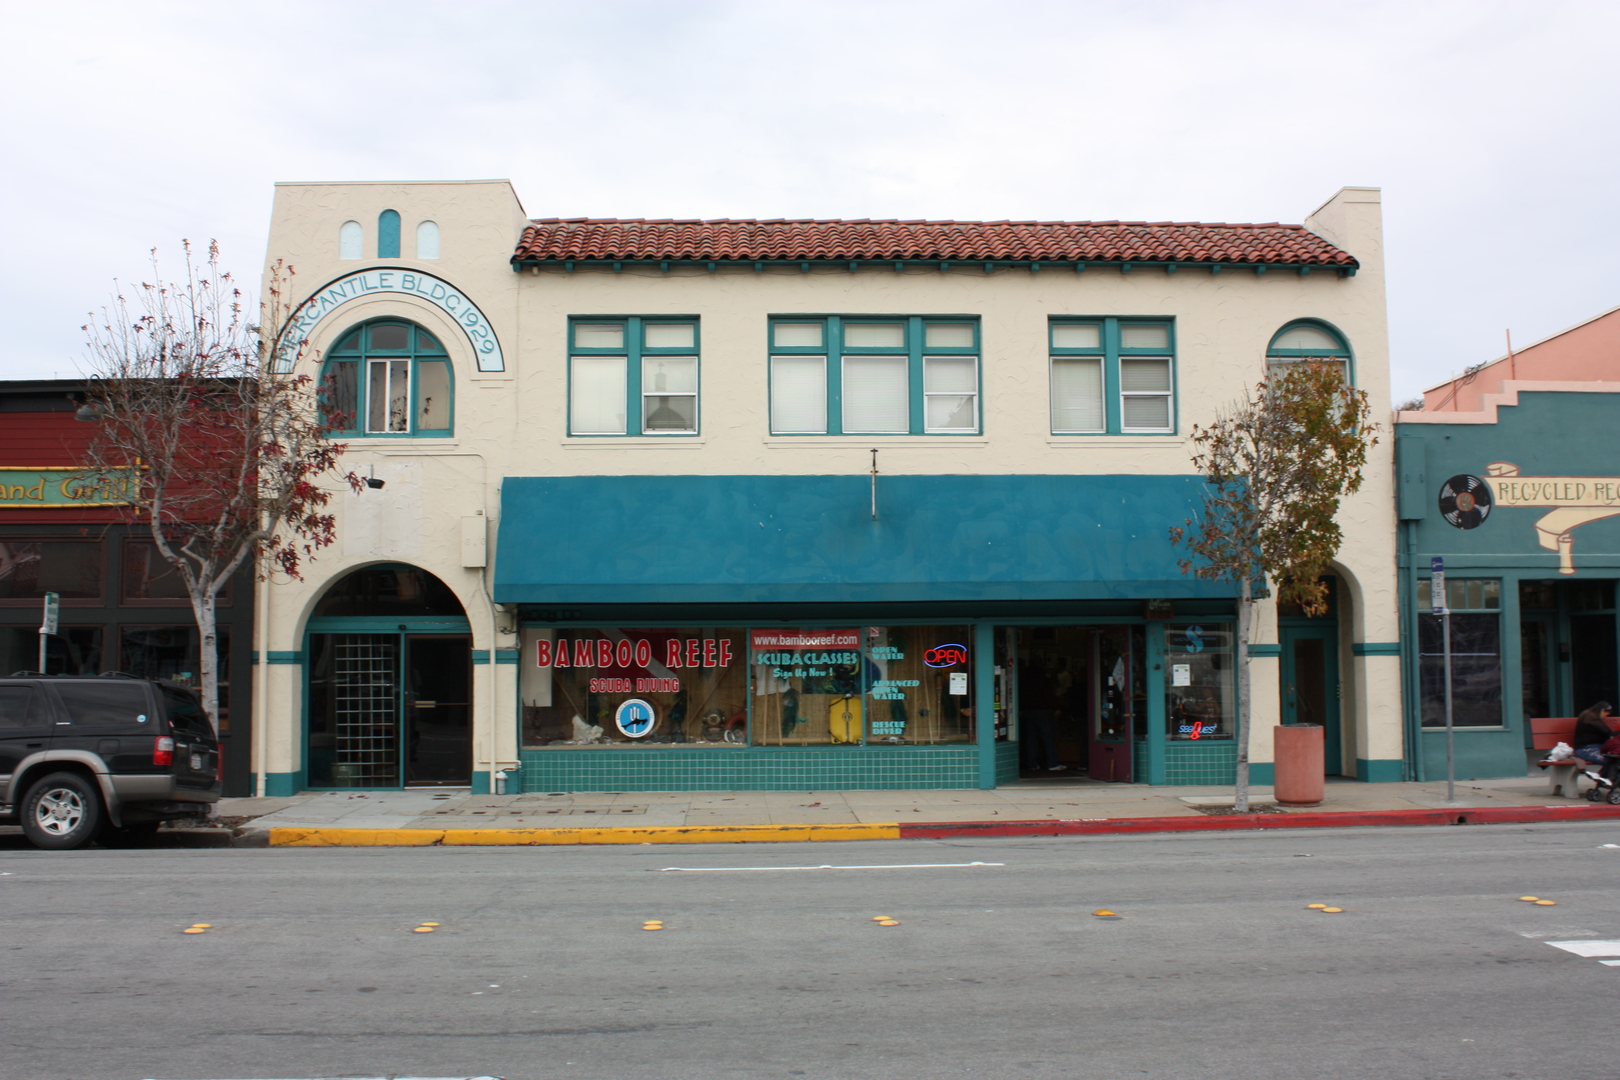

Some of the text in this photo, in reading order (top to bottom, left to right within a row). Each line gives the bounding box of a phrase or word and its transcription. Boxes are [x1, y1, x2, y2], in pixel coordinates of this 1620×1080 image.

[275, 273, 394, 363] MERCANTILE
[401, 273, 462, 315] BLDG.
[1498, 482, 1587, 505] RECYCLED
[754, 633, 858, 646] www.bambooreef.com
[536, 638, 733, 668] BAMBOO REEF
[871, 646, 898, 654] OPEN
[923, 649, 967, 664] OPEN
[756, 652, 858, 665] SCUBA CLASSES
[772, 667, 793, 680] Sign
[795, 668, 807, 680] Up
[589, 678, 680, 693] SCUBA DIVING
